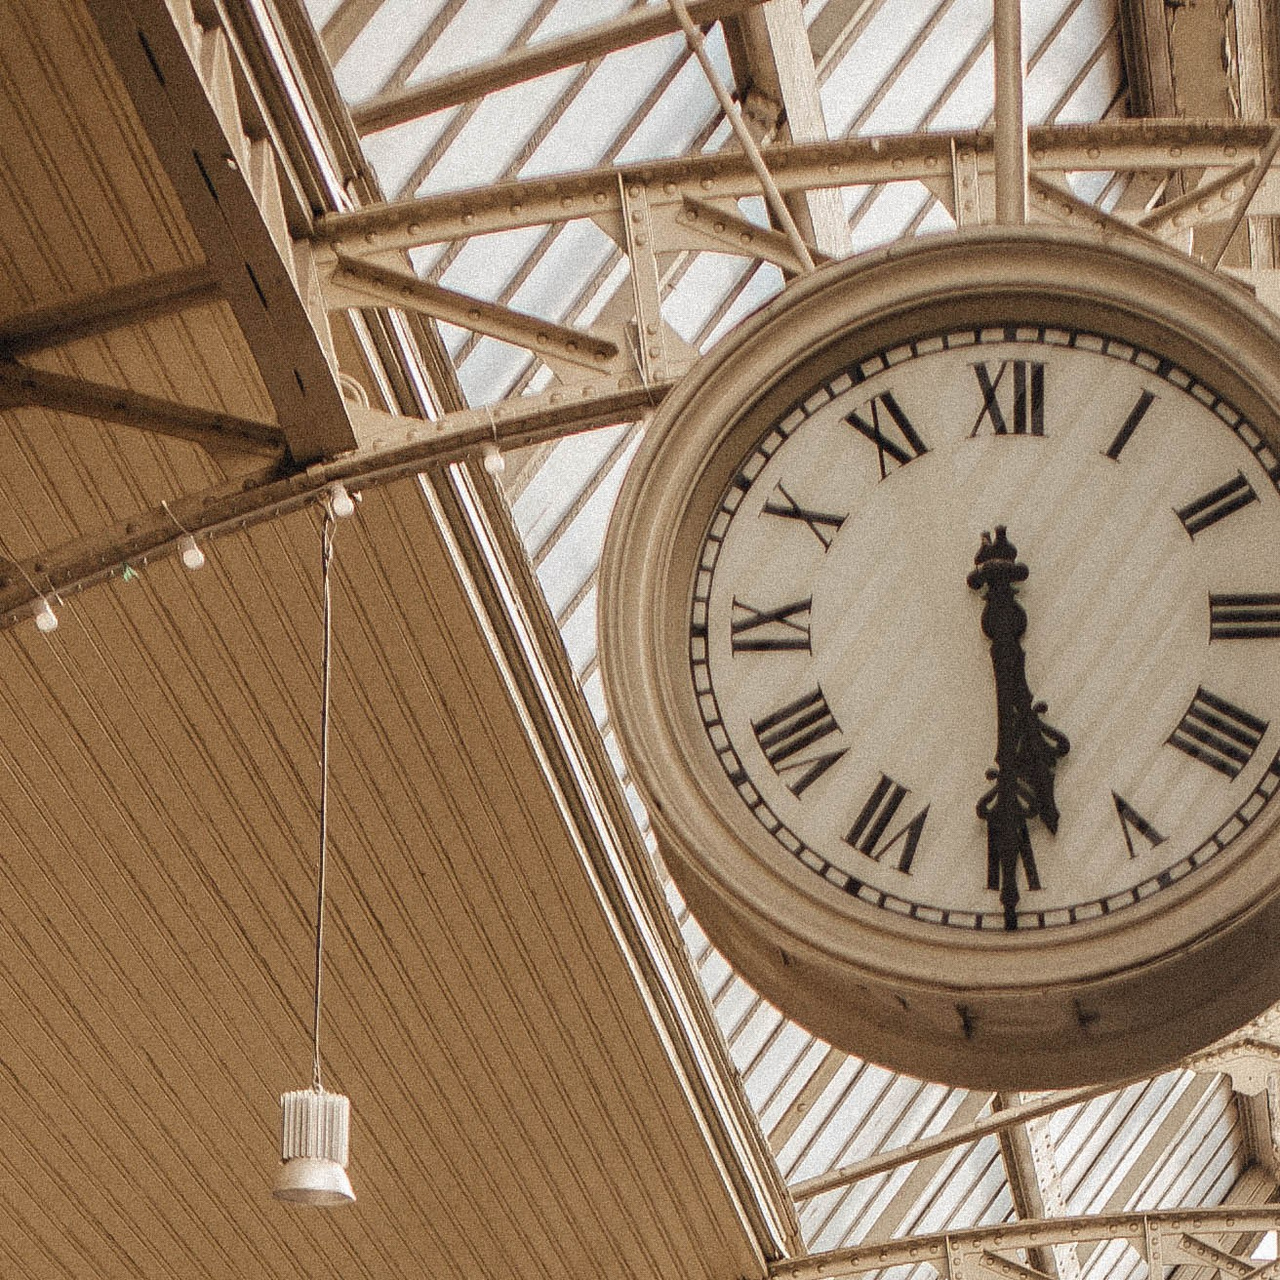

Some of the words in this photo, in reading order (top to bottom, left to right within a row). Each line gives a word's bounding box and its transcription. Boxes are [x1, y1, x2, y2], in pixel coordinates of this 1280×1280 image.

[843, 389, 931, 481] XI
[971, 359, 1048, 439] XII
[1103, 388, 1158, 463] I
[760, 480, 849, 553] X
[1173, 471, 1259, 541] II
[730, 596, 813, 657] IX
[751, 683, 850, 801] VIII
[1162, 684, 1270, 784] IIII
[841, 773, 931, 876] VII
[1111, 789, 1169, 860] V
